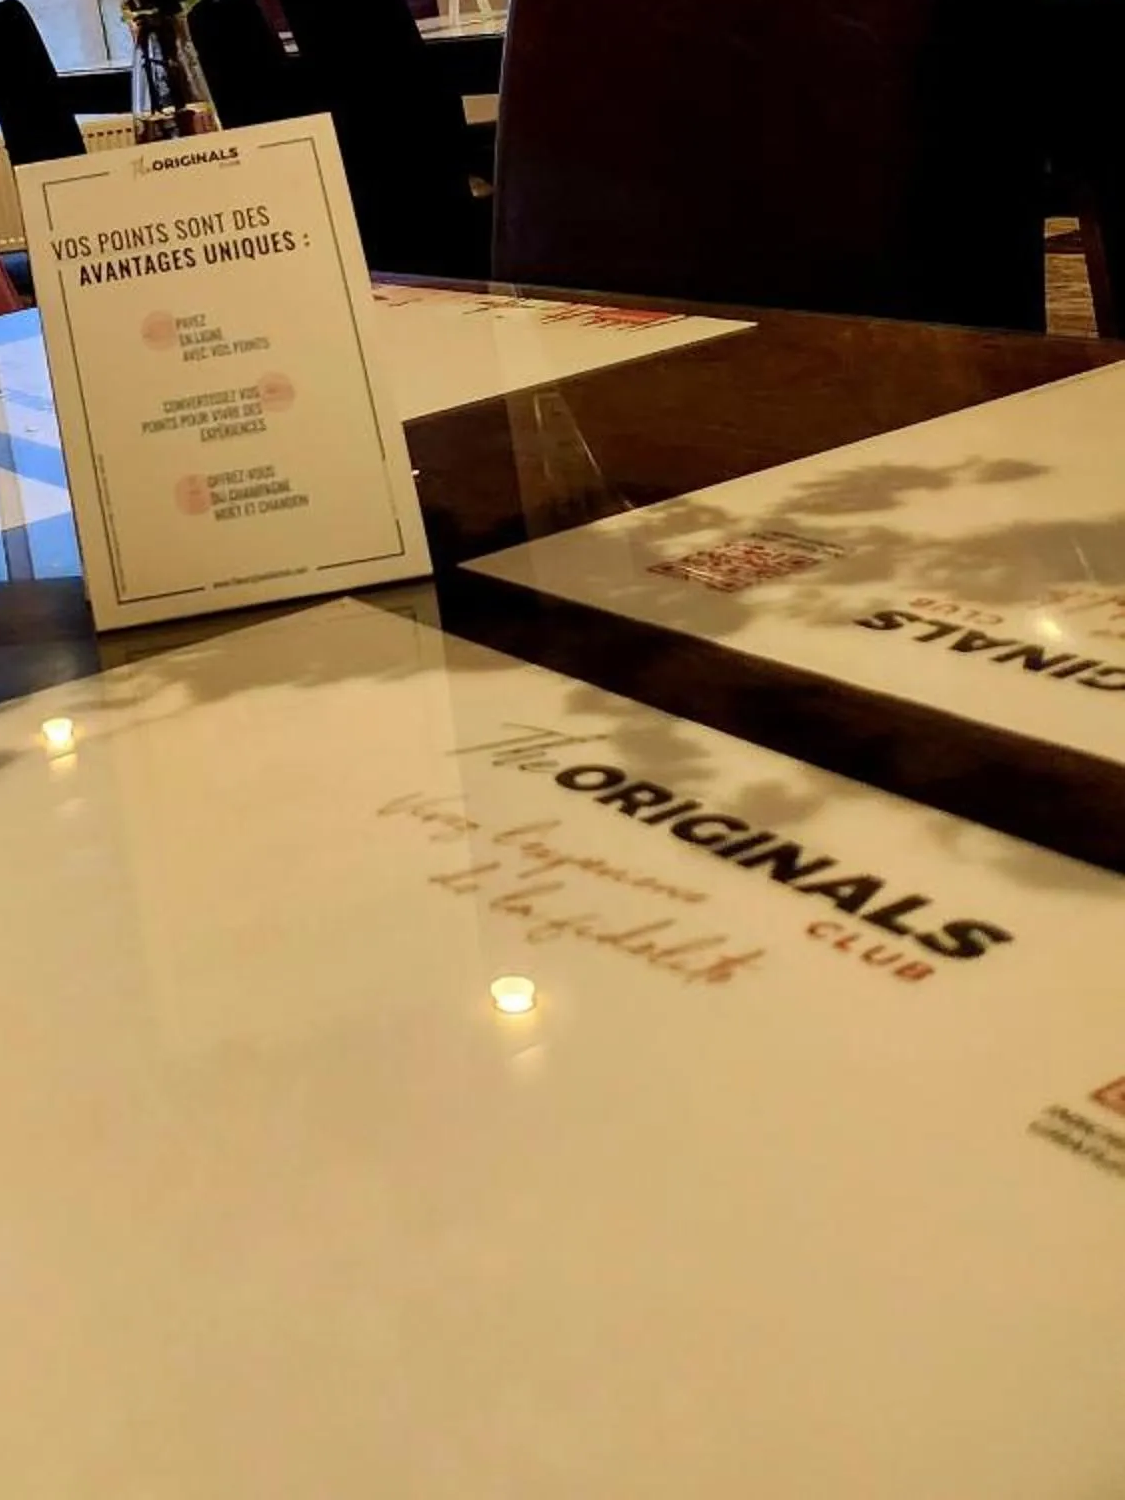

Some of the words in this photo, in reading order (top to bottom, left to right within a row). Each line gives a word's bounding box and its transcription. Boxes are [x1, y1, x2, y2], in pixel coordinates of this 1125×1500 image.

[151, 147, 239, 171] ORIGINALS
[50, 236, 92, 261] VOS
[98, 222, 169, 253] POINTS
[173, 211, 225, 241] SONT
[233, 205, 270, 230] DES
[80, 246, 196, 286] AVANTAGES
[203, 230, 296, 265] UNIQUES
[853, 610, 1125, 691] GINALS
[446, 722, 609, 774] The
[555, 762, 1014, 960] ORIGINALS
[806, 920, 935, 982] CLUB
